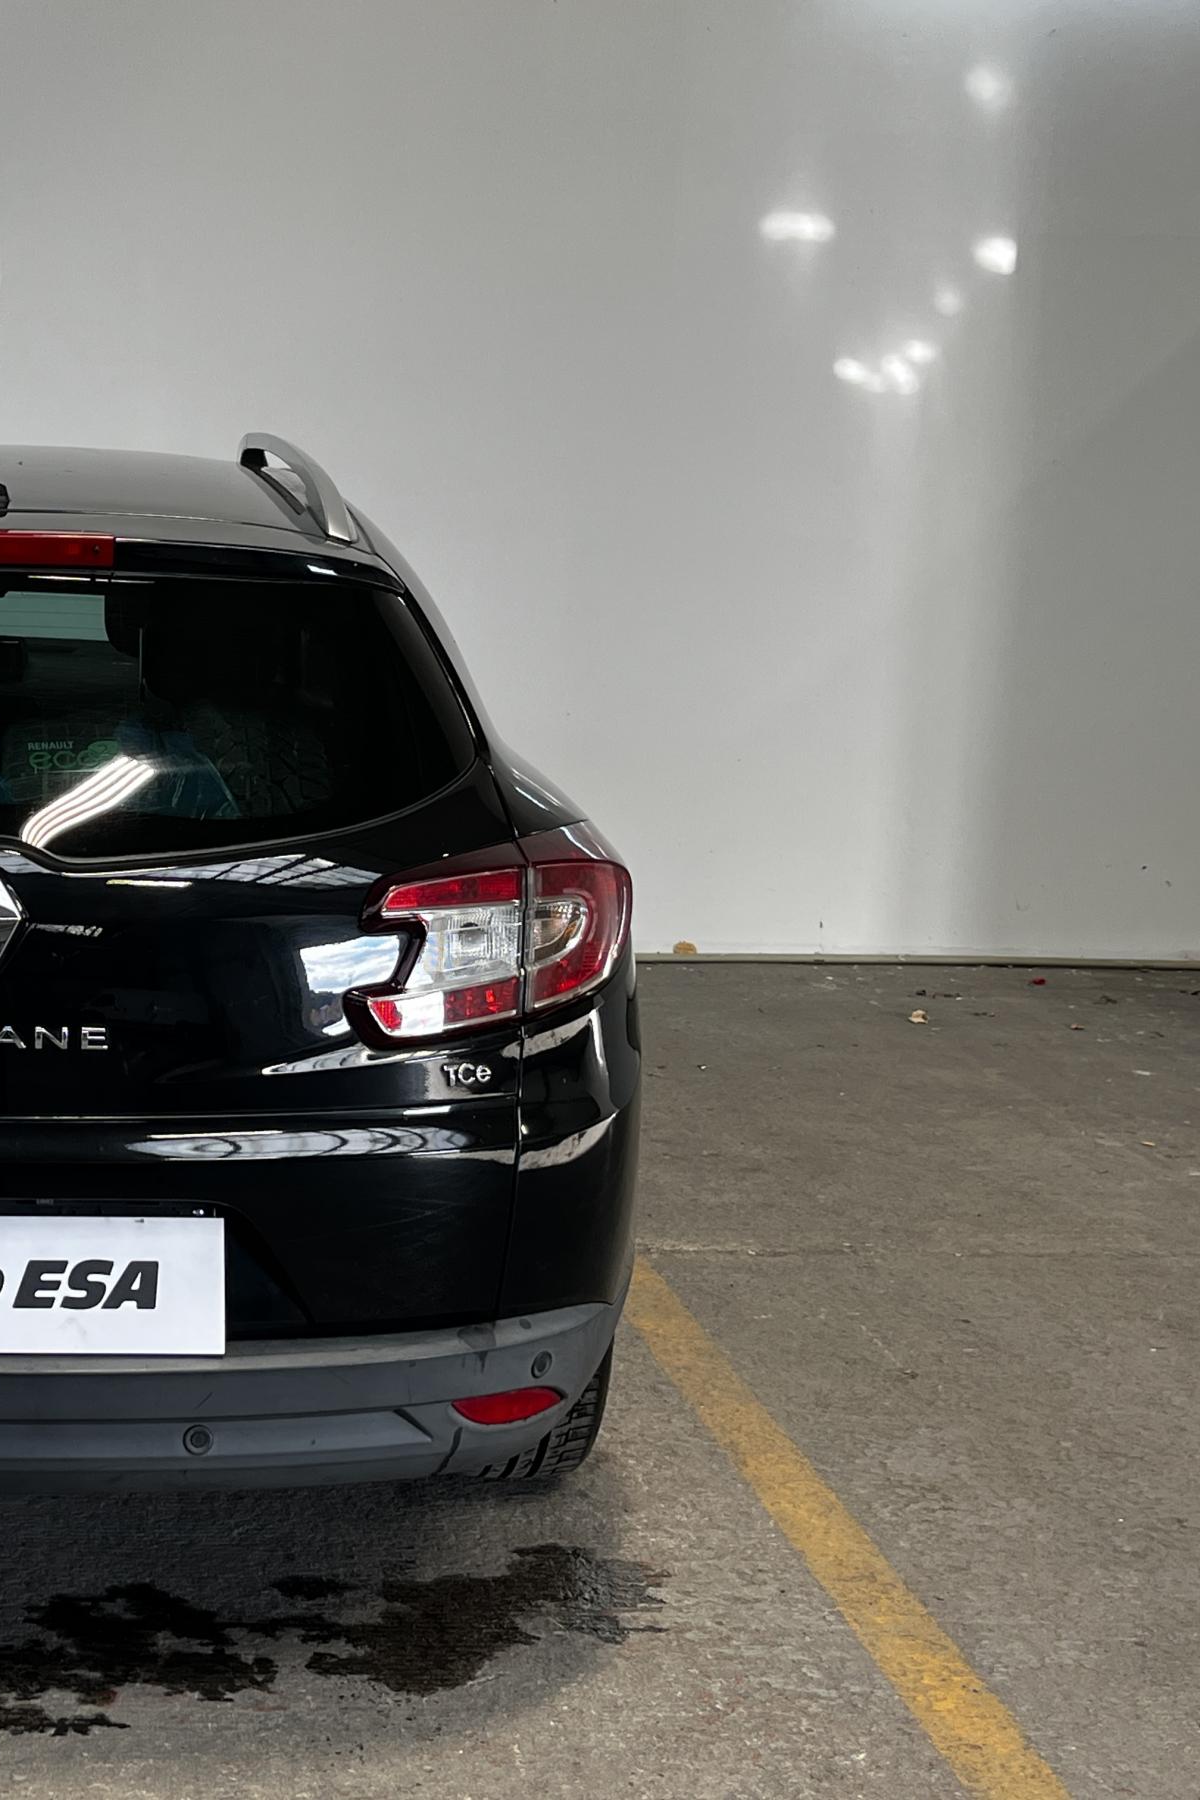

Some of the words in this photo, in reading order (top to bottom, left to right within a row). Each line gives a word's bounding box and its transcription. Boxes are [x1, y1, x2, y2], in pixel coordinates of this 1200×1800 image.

[27, 740, 74, 751] RENAULT
[443, 1063, 493, 1087] TCe
[12, 1260, 160, 1310] ESA
